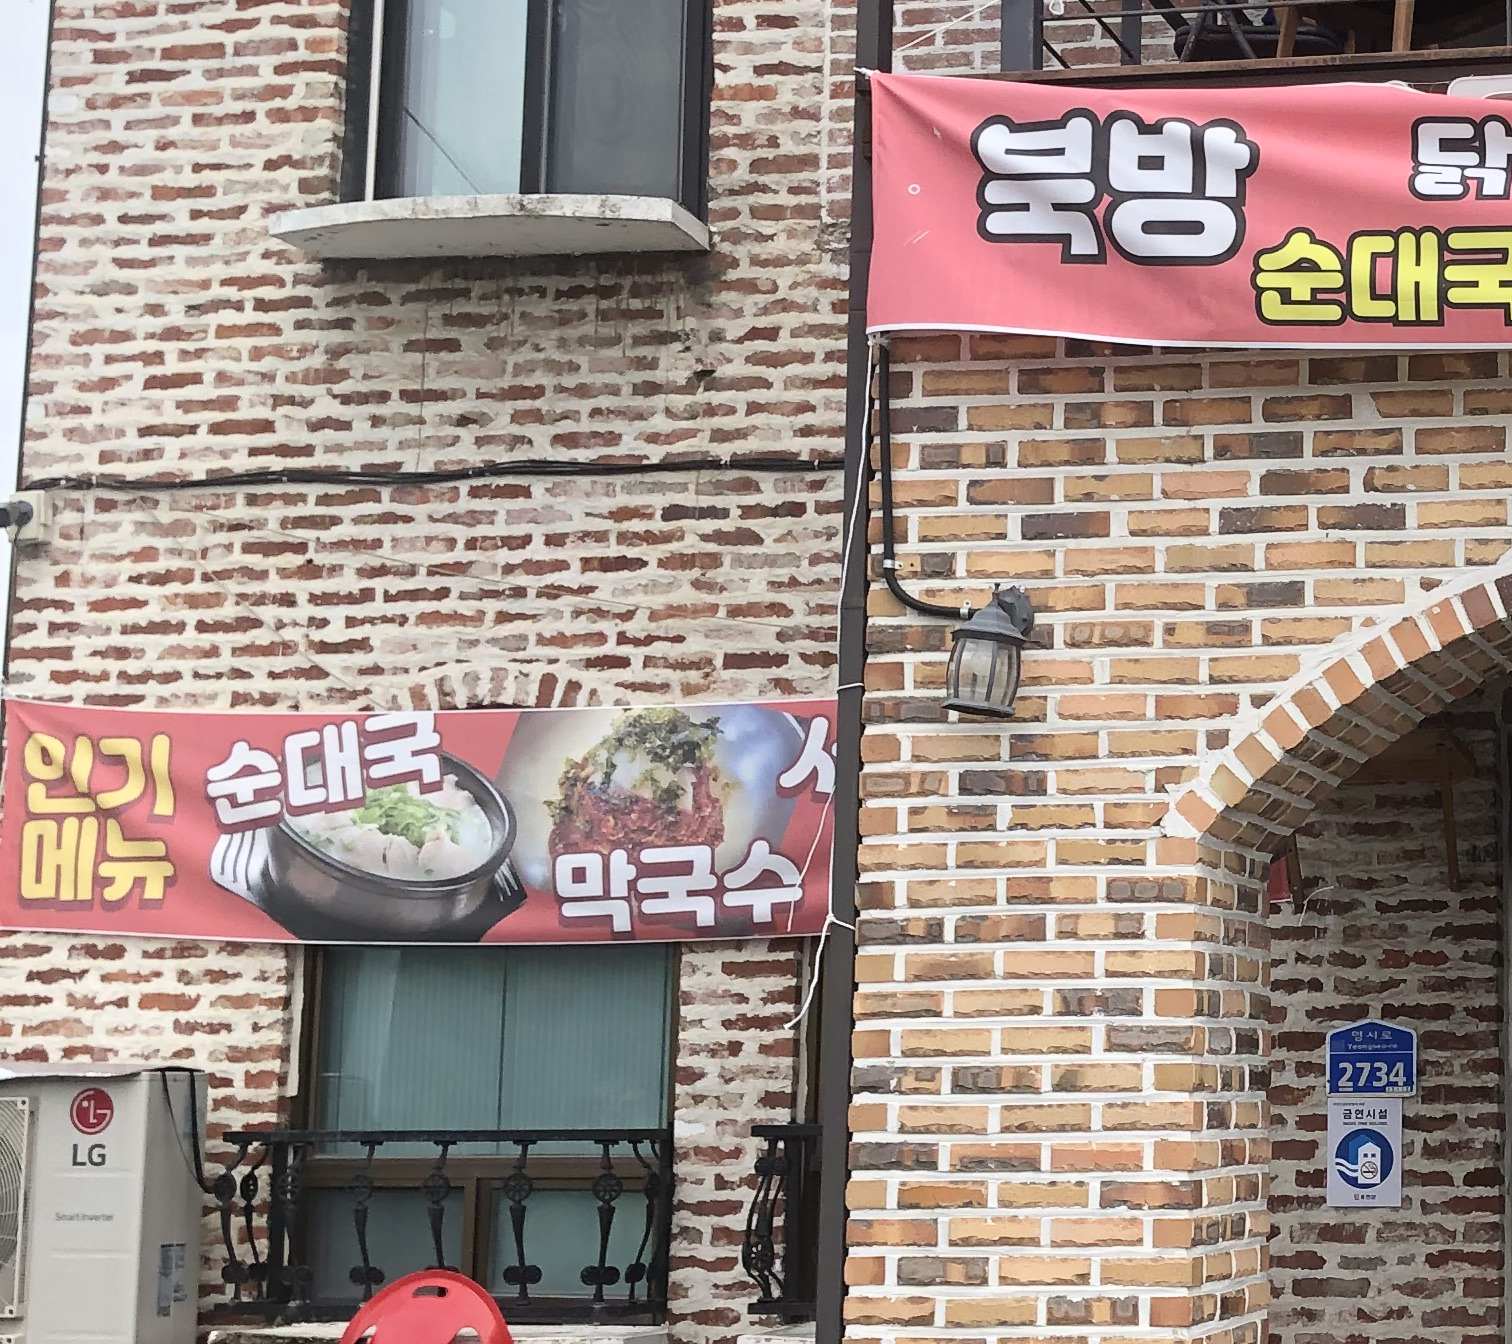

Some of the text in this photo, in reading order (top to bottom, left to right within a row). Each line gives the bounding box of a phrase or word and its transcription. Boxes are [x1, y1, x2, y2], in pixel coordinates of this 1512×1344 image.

[973, 109, 1259, 265] 북방
[24, 732, 175, 816] 인기
[206, 712, 442, 826] 순대국
[20, 816, 176, 902] 메뉴
[555, 840, 803, 932] 막국수
[1337, 1061, 1407, 1088] 2734
[1342, 1108, 1388, 1120] 금연시설
[72, 1143, 106, 1166] LG
